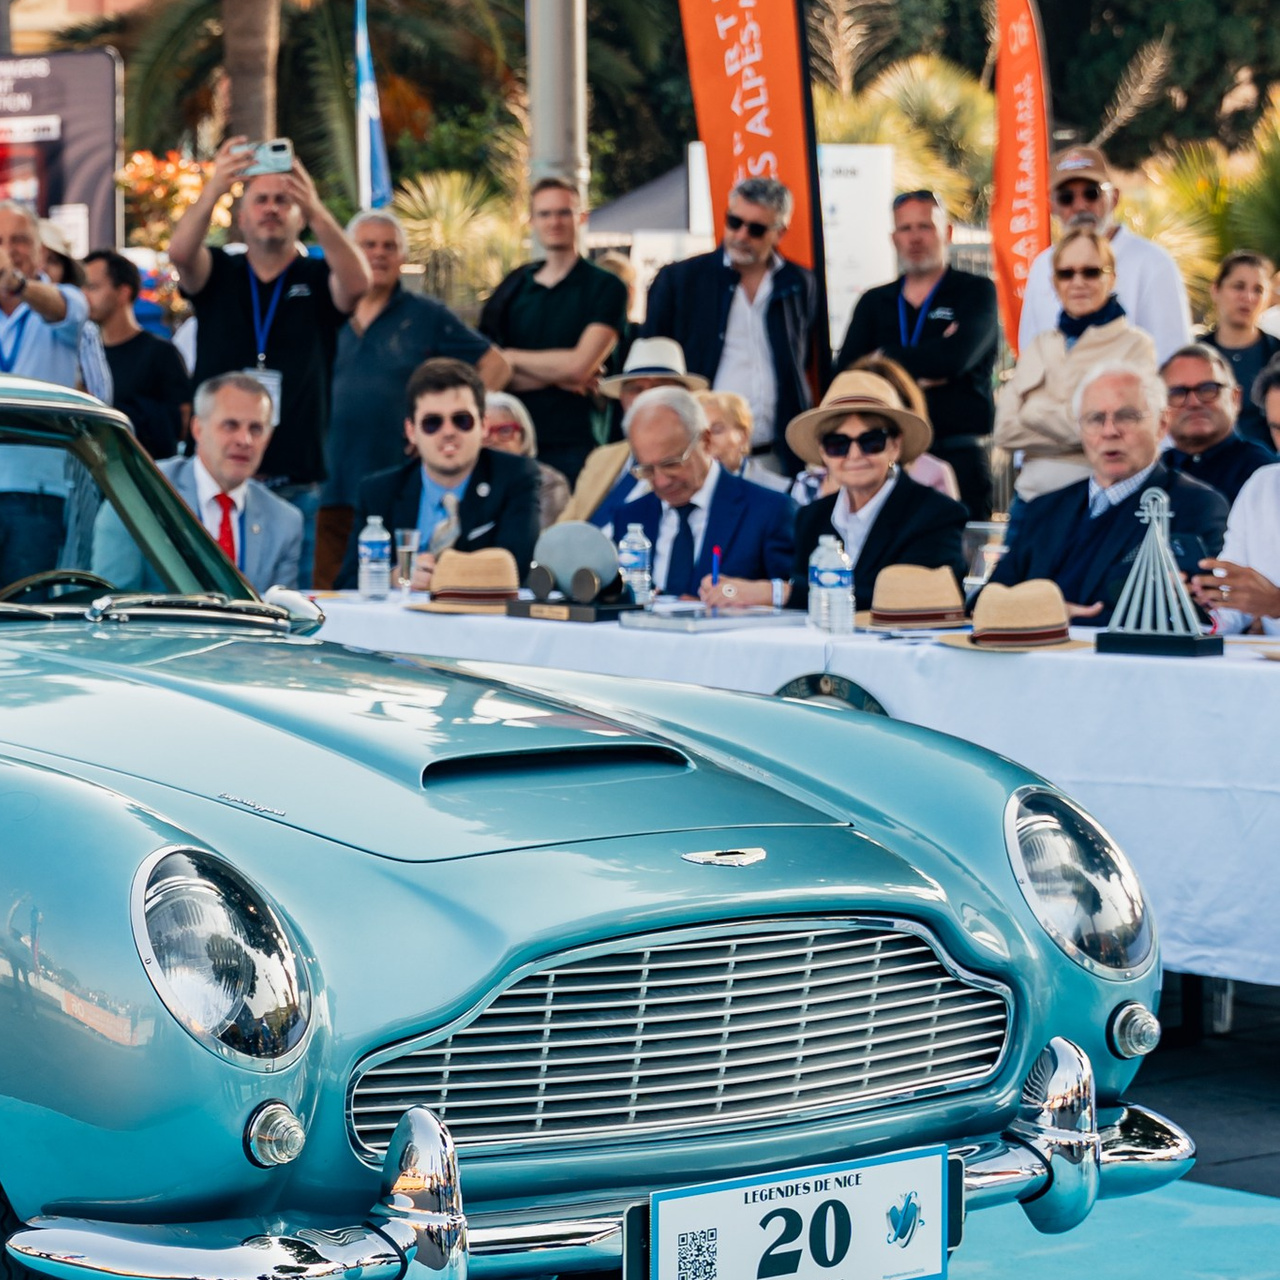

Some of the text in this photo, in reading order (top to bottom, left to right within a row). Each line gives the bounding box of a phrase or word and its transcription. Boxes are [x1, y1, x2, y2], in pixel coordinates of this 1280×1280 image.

[743, 1173, 862, 1205] LEGENDES DE NICE
[756, 1199, 852, 1280] 20
